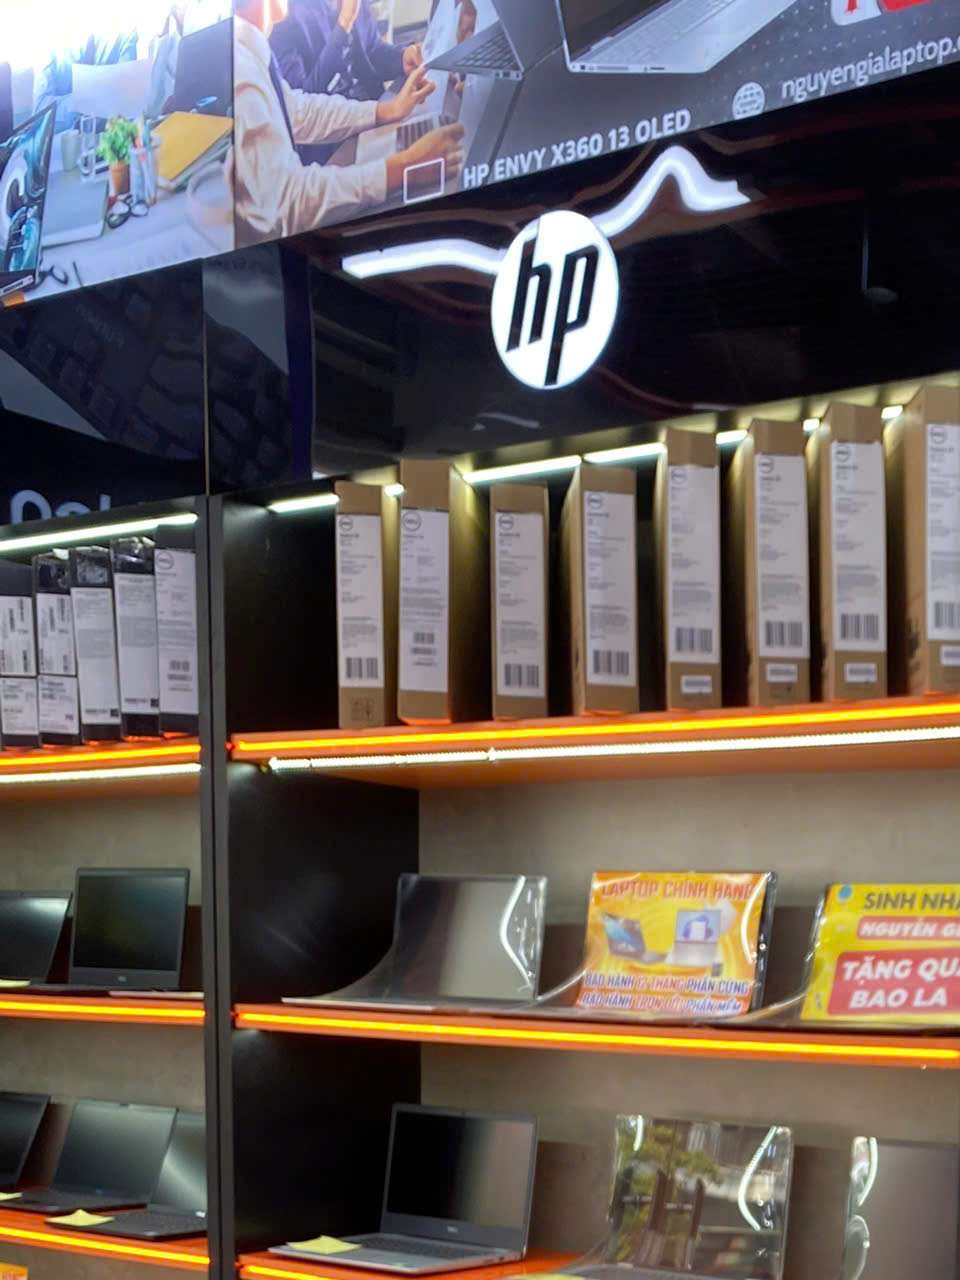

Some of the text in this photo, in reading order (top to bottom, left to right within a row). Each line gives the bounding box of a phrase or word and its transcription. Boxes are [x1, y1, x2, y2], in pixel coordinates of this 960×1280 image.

[463, 108, 692, 189] HP ENVY X360 13 OLED
[503, 230, 602, 387] hp
[863, 891, 916, 911] SINH
[842, 955, 914, 985] TẶNG
[850, 987, 948, 1009] BAO LA
